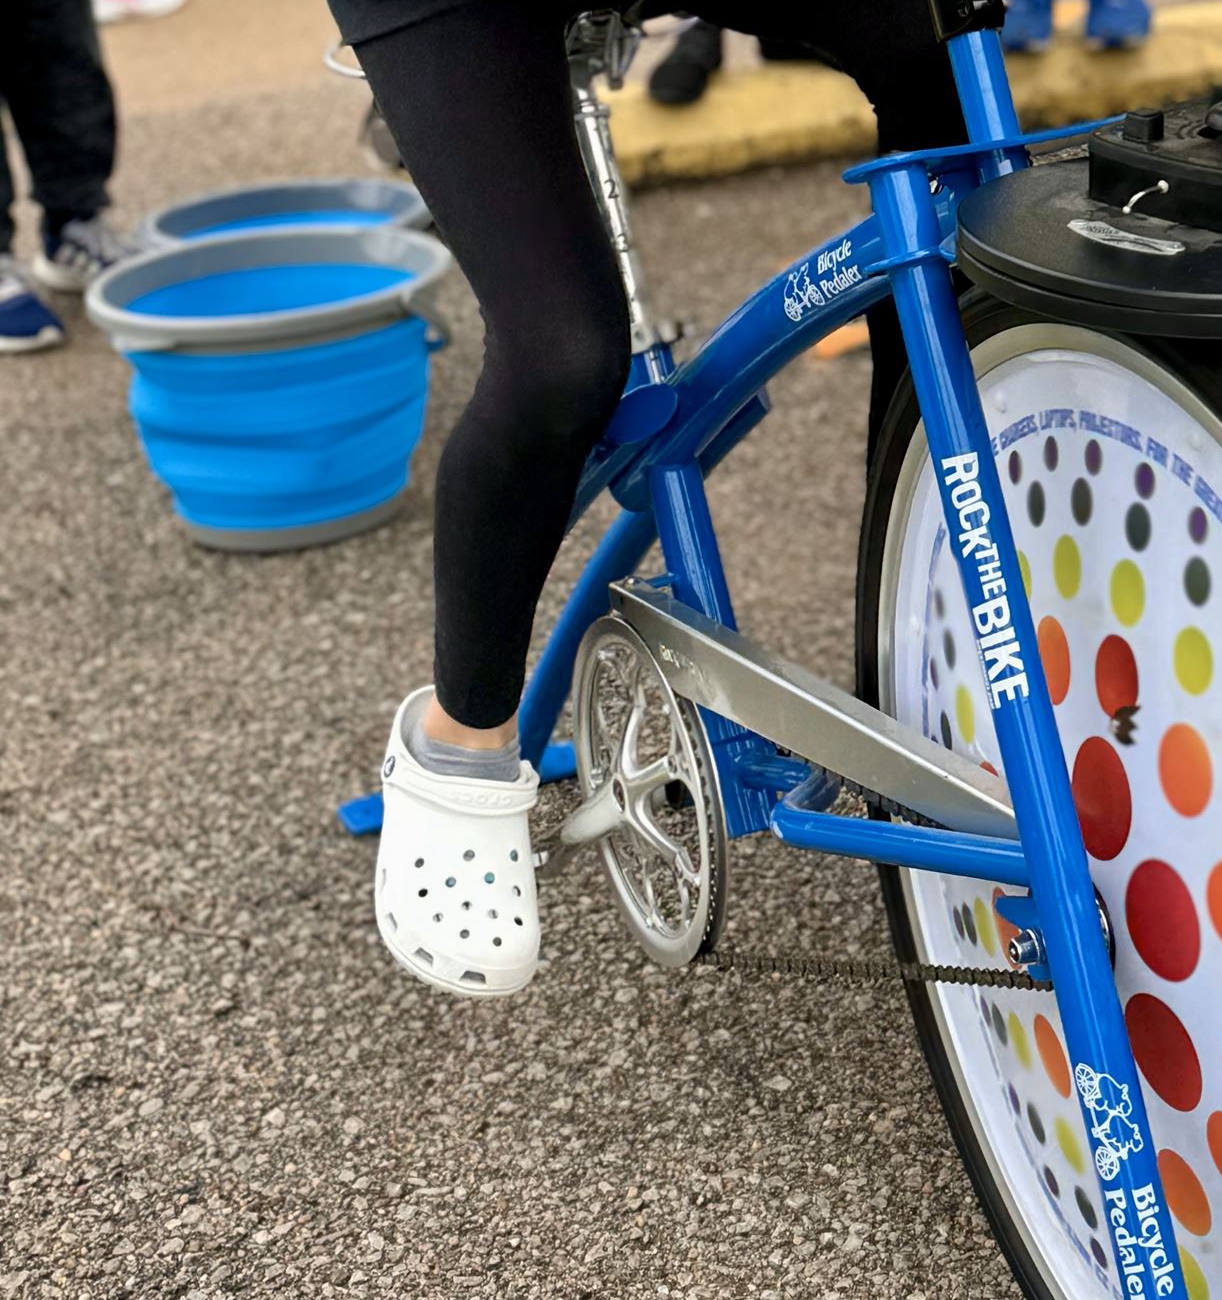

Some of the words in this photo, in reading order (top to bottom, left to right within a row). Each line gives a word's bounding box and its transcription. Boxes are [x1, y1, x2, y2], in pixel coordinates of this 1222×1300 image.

[817, 239, 852, 275] Bicycle
[819, 264, 863, 299] Pedaler
[1132, 1182, 1175, 1297] Bicycle
